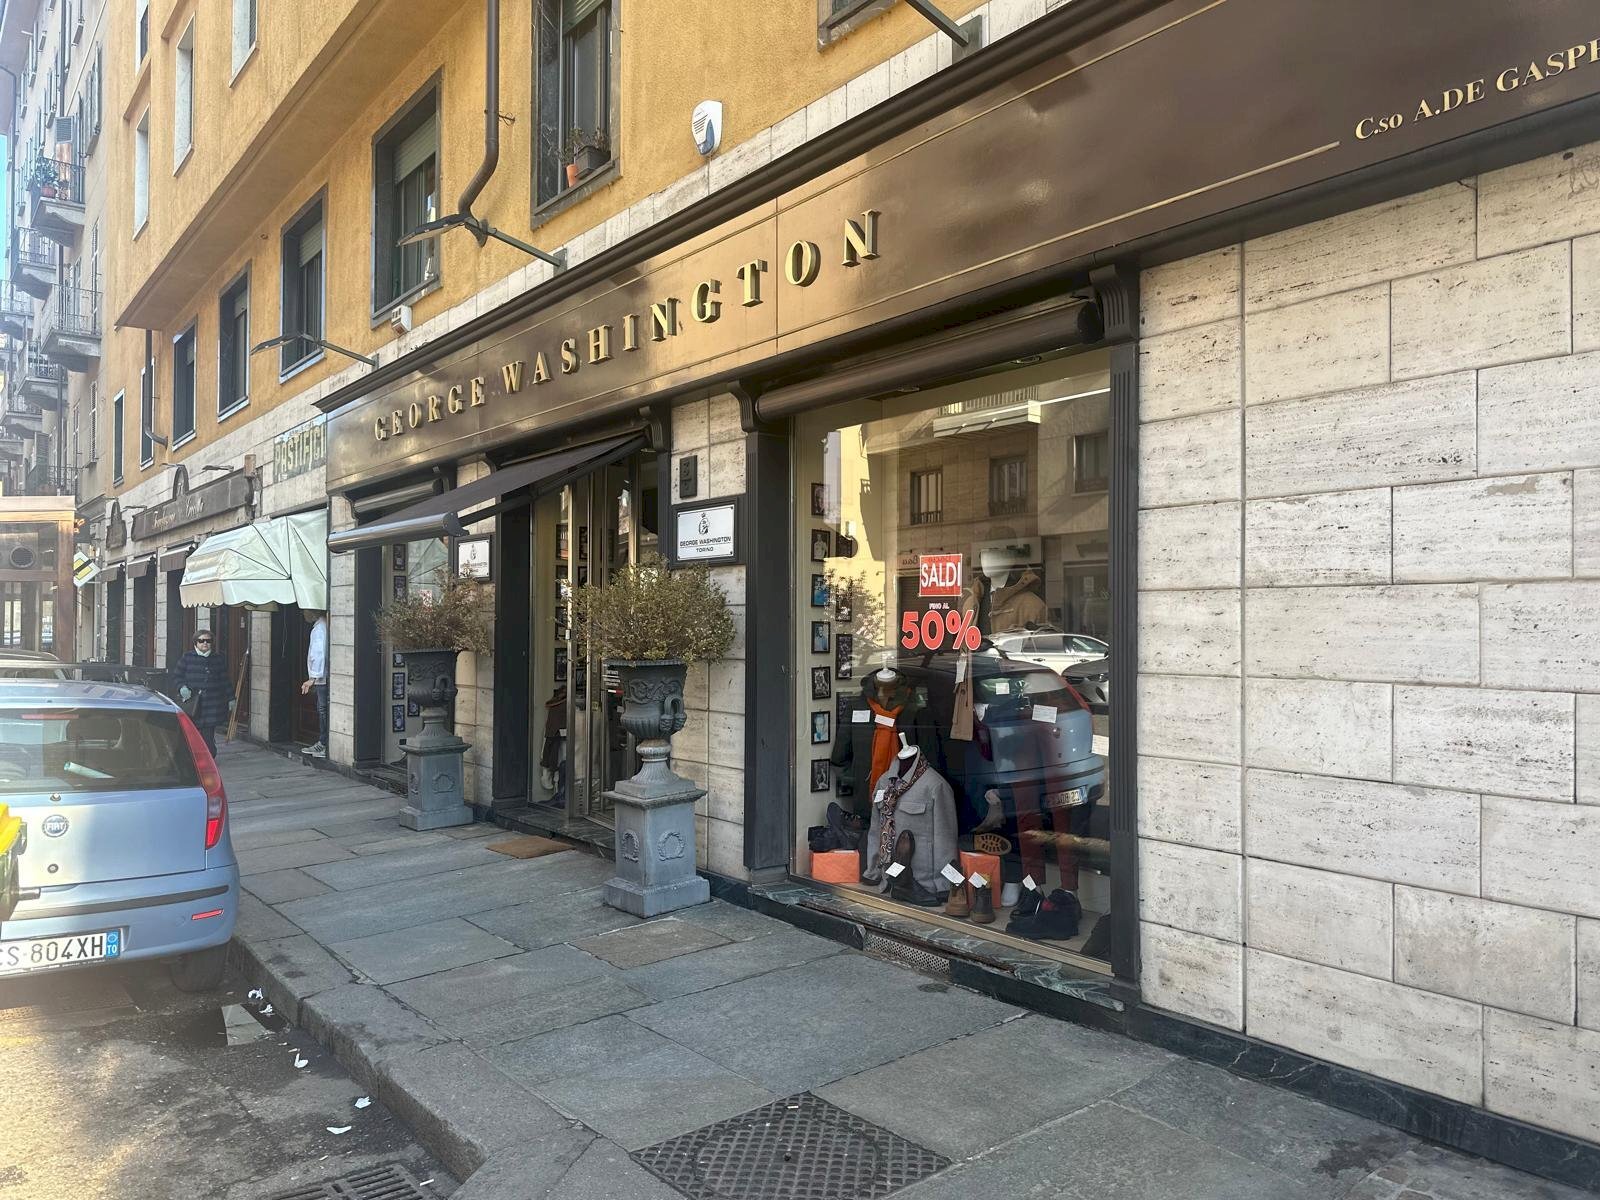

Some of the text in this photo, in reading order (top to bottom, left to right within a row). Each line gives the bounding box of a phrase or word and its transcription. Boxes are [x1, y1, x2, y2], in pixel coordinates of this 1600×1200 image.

[1355, 113, 1403, 140] C.so
[375, 208, 881, 440] GEORGE WASHINGTON
[275, 424, 326, 476] PASTIFICI
[680, 536, 731, 547] GEORGE WASHINGTON
[921, 561, 961, 588] SALDI
[902, 610, 982, 651] 50%
[46, 822, 65, 831] FIAT
[107, 945, 117, 954] TO
